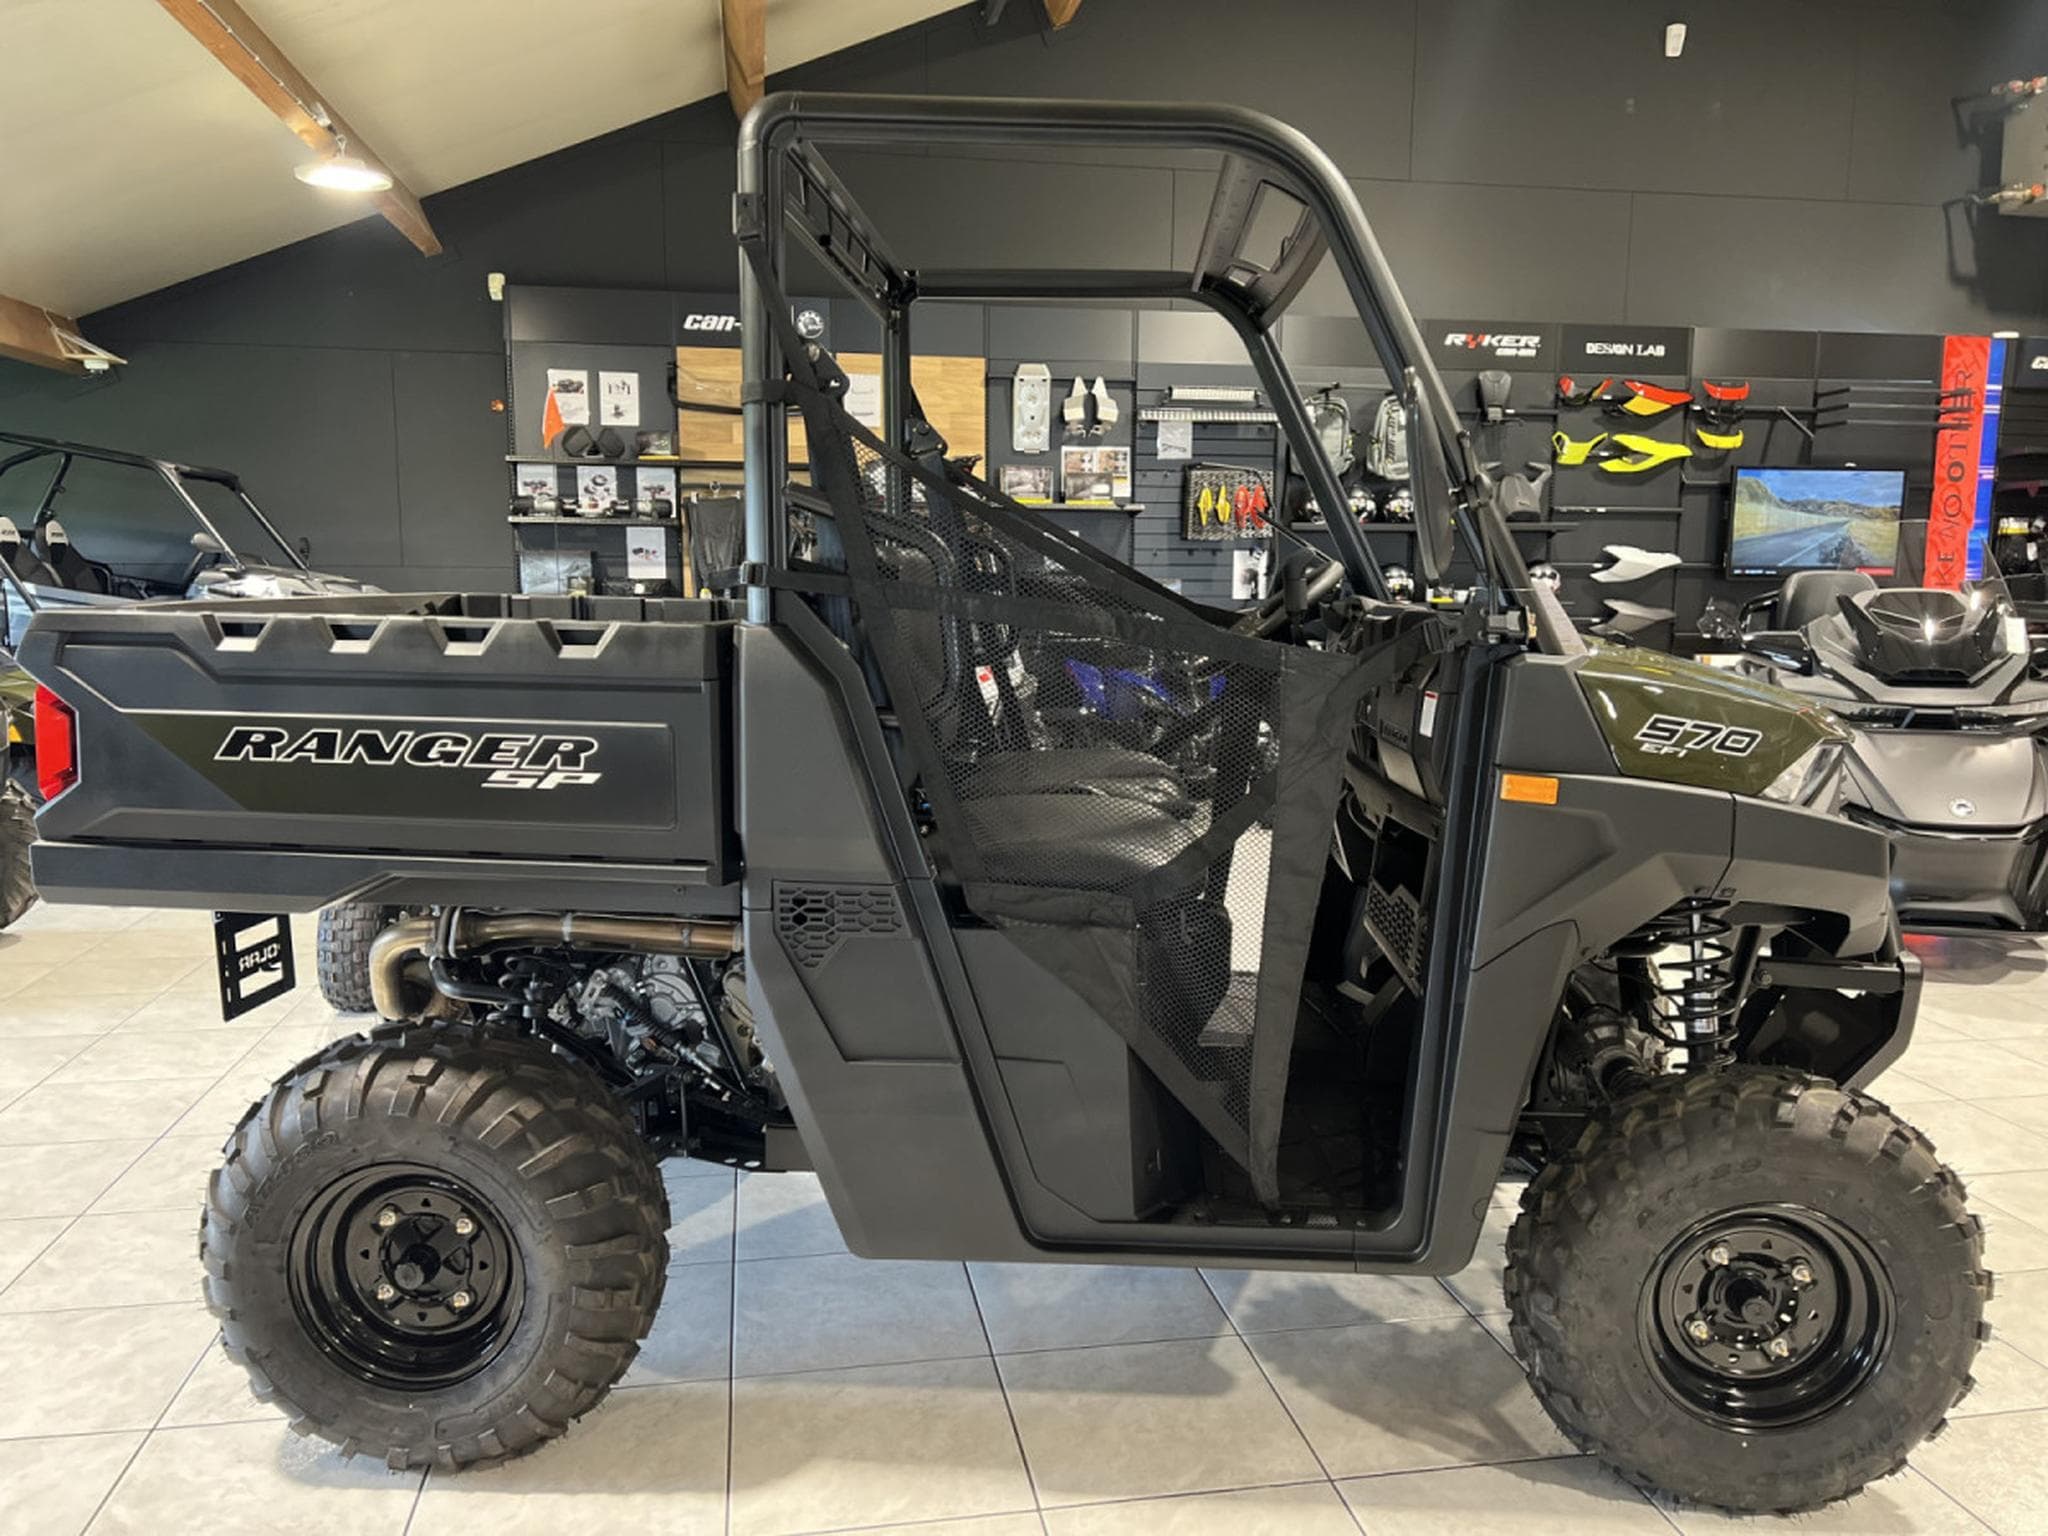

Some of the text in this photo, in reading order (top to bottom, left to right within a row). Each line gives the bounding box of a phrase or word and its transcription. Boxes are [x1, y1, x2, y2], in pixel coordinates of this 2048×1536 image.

[683, 314, 743, 332] can-
[1585, 342, 1666, 357] DESIGN LAB
[1633, 713, 1763, 757] 570
[213, 726, 599, 770] RANGER
[1640, 742, 1688, 758] EFI
[481, 769, 602, 790] SP
